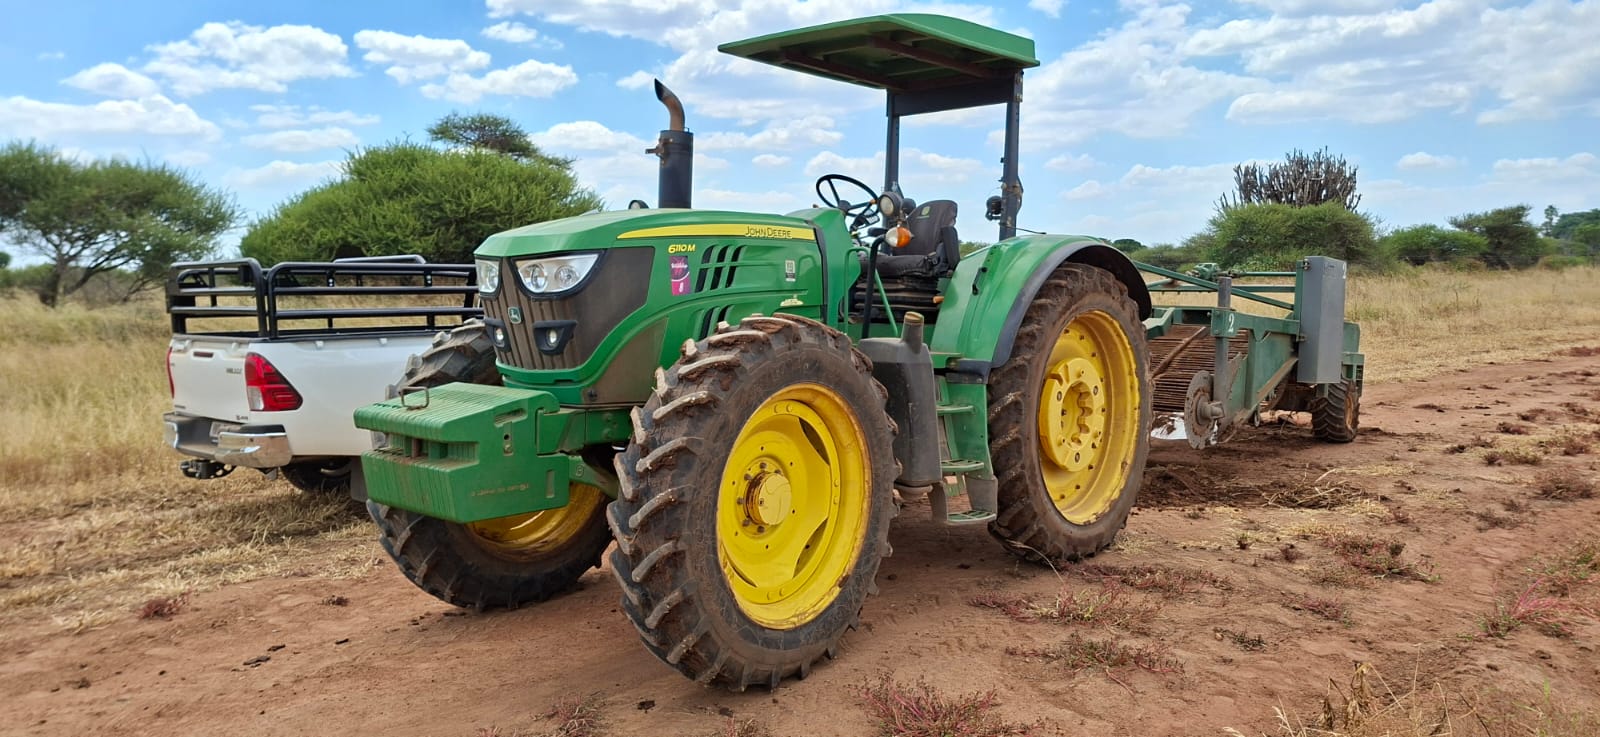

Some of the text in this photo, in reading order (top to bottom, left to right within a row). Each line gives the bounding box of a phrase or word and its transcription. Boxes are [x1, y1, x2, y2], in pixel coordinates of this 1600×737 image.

[745, 226, 792, 237] JOHN DEERE
[1228, 313, 1235, 333] 2
